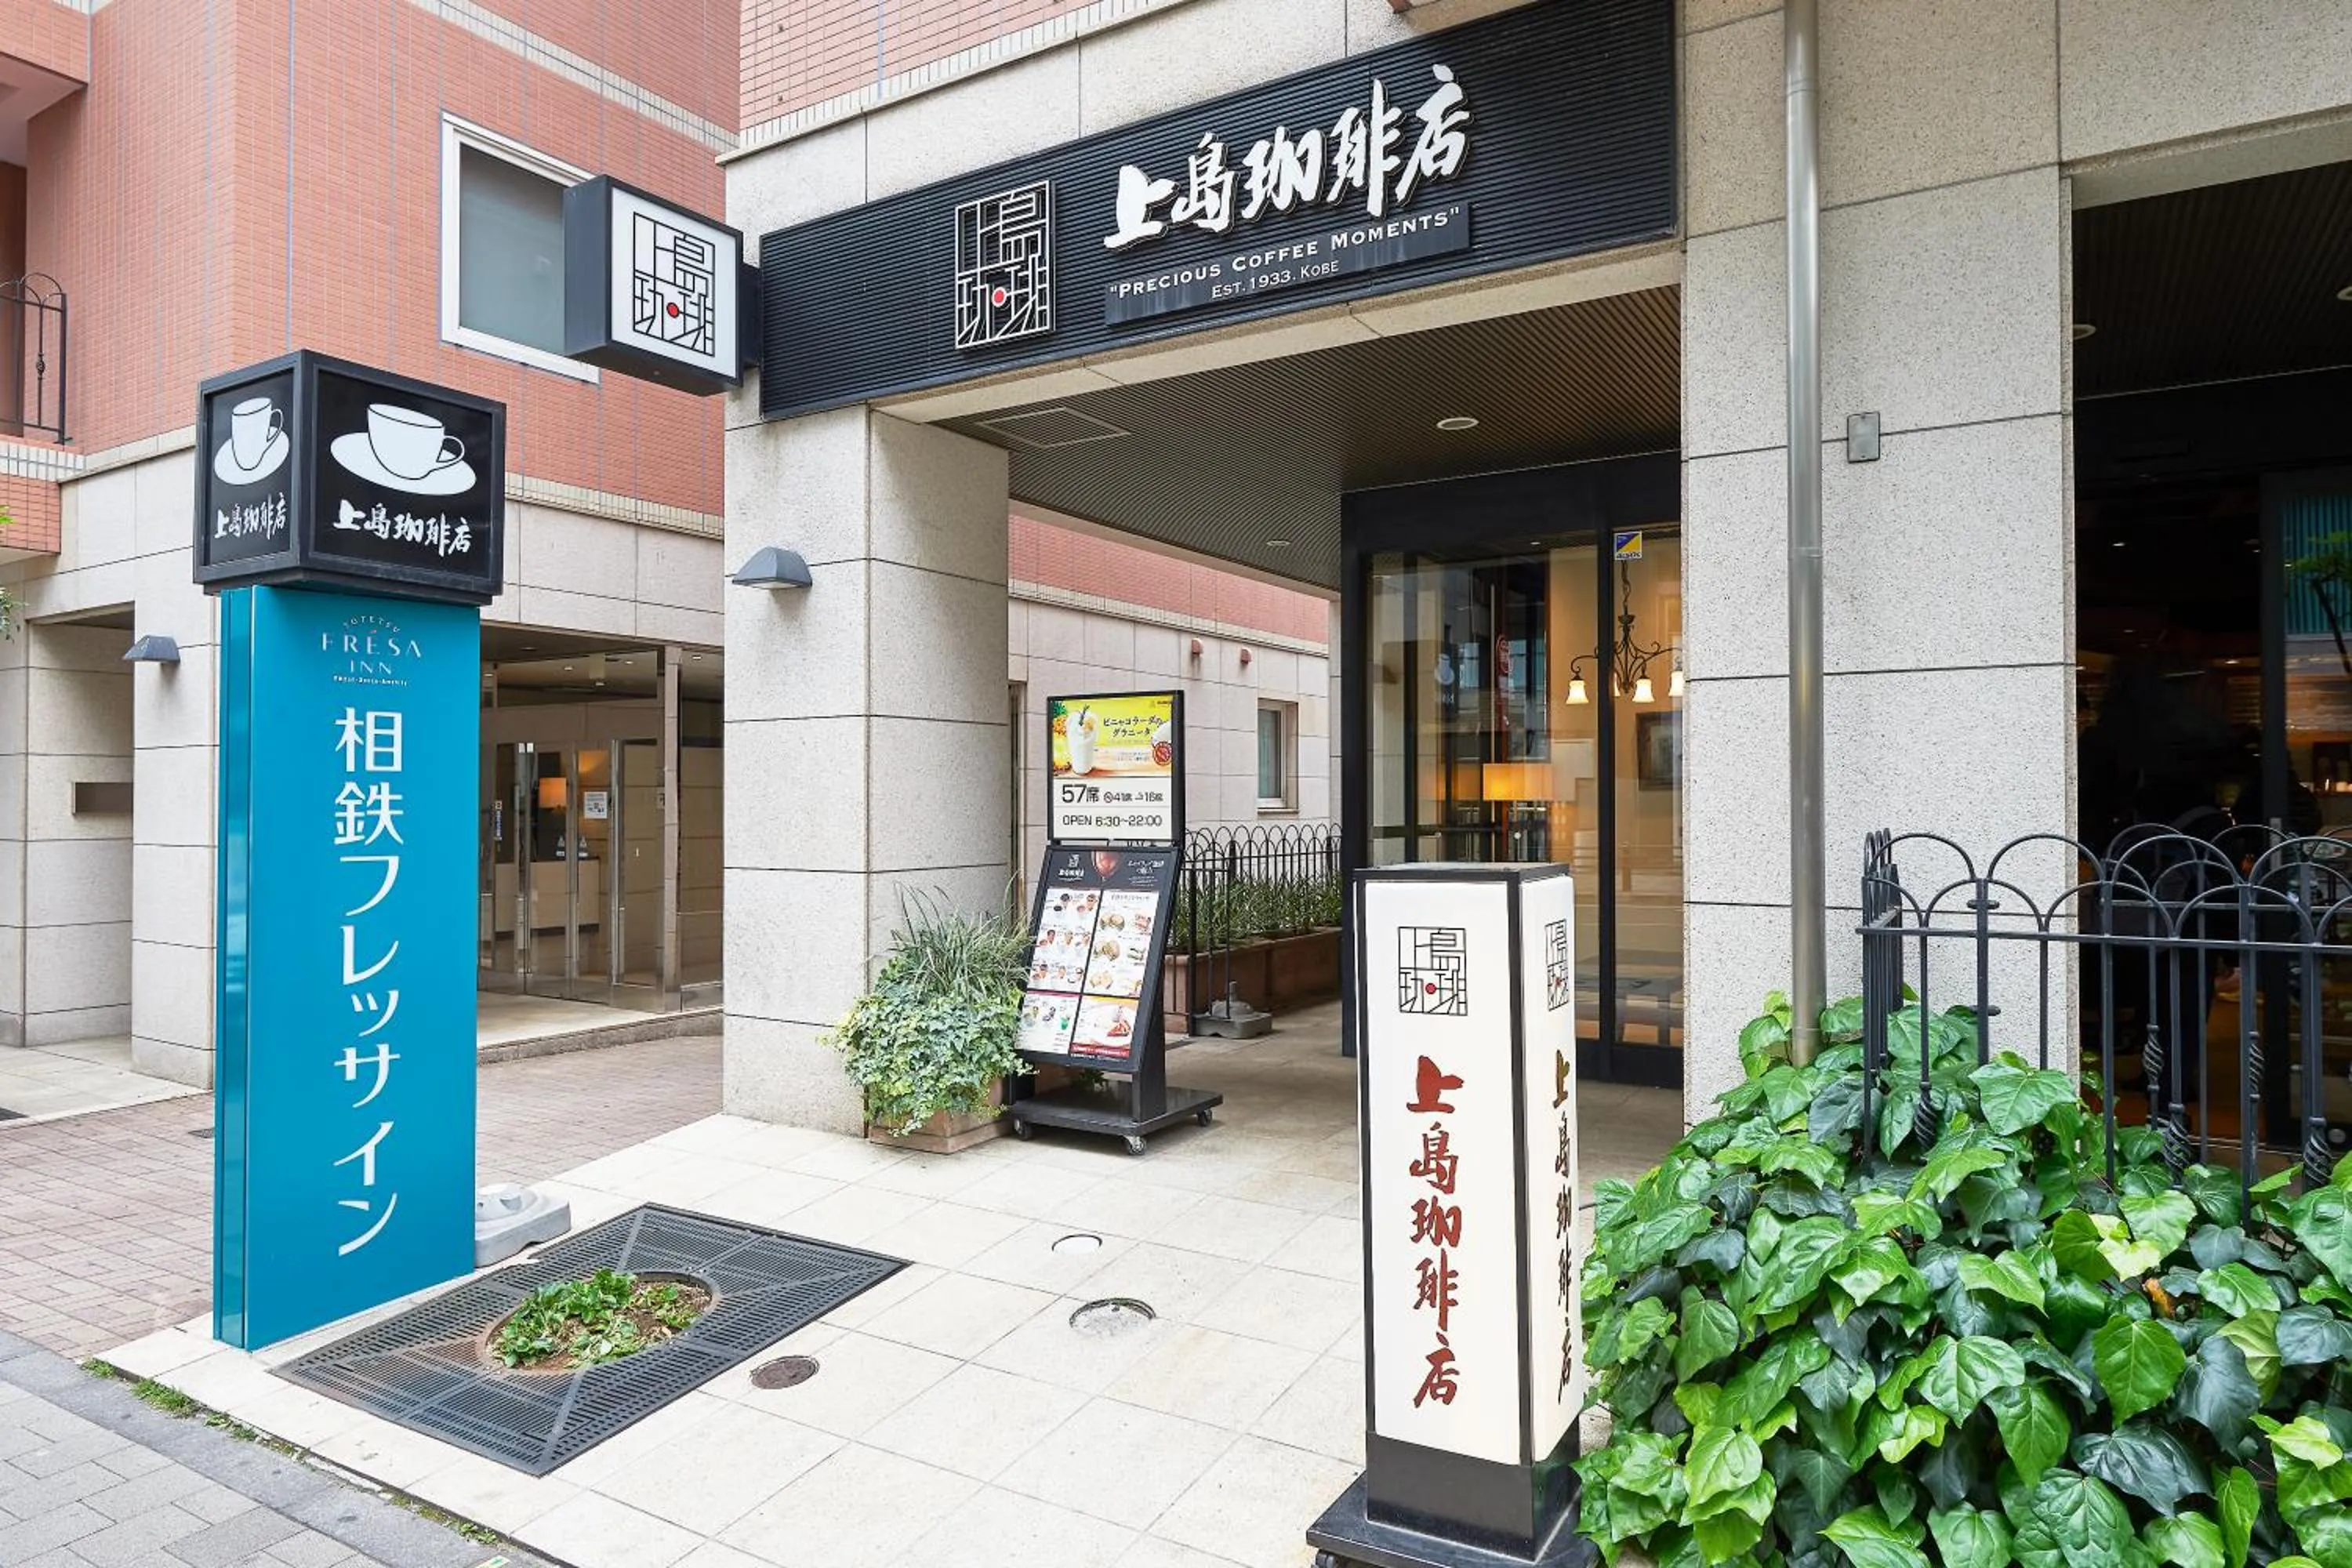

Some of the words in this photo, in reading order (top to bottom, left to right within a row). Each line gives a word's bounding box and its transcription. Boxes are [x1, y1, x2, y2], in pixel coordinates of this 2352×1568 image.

[1103, 64, 1471, 249] 上島珈琲店
[1109, 262, 1221, 299] "PRECIOUS
[1232, 241, 1319, 272] COFFEE
[1331, 206, 1460, 251] MOMENTS"
[1211, 282, 1246, 299] EST.
[1250, 271, 1296, 290] 1933.
[1301, 260, 1340, 278] KOBE
[214, 492, 288, 541] 上島珈琲店
[332, 498, 474, 557] 上島珈琲店
[350, 659, 392, 675] INN
[1062, 784, 1100, 804] 57席
[1062, 815, 1092, 826] OPEN
[333, 706, 404, 1257] 相鉄フレッサイン
[1407, 1054, 1465, 1408] 上島珈琲店
[1553, 1048, 1573, 1406] 上島珈琲店
